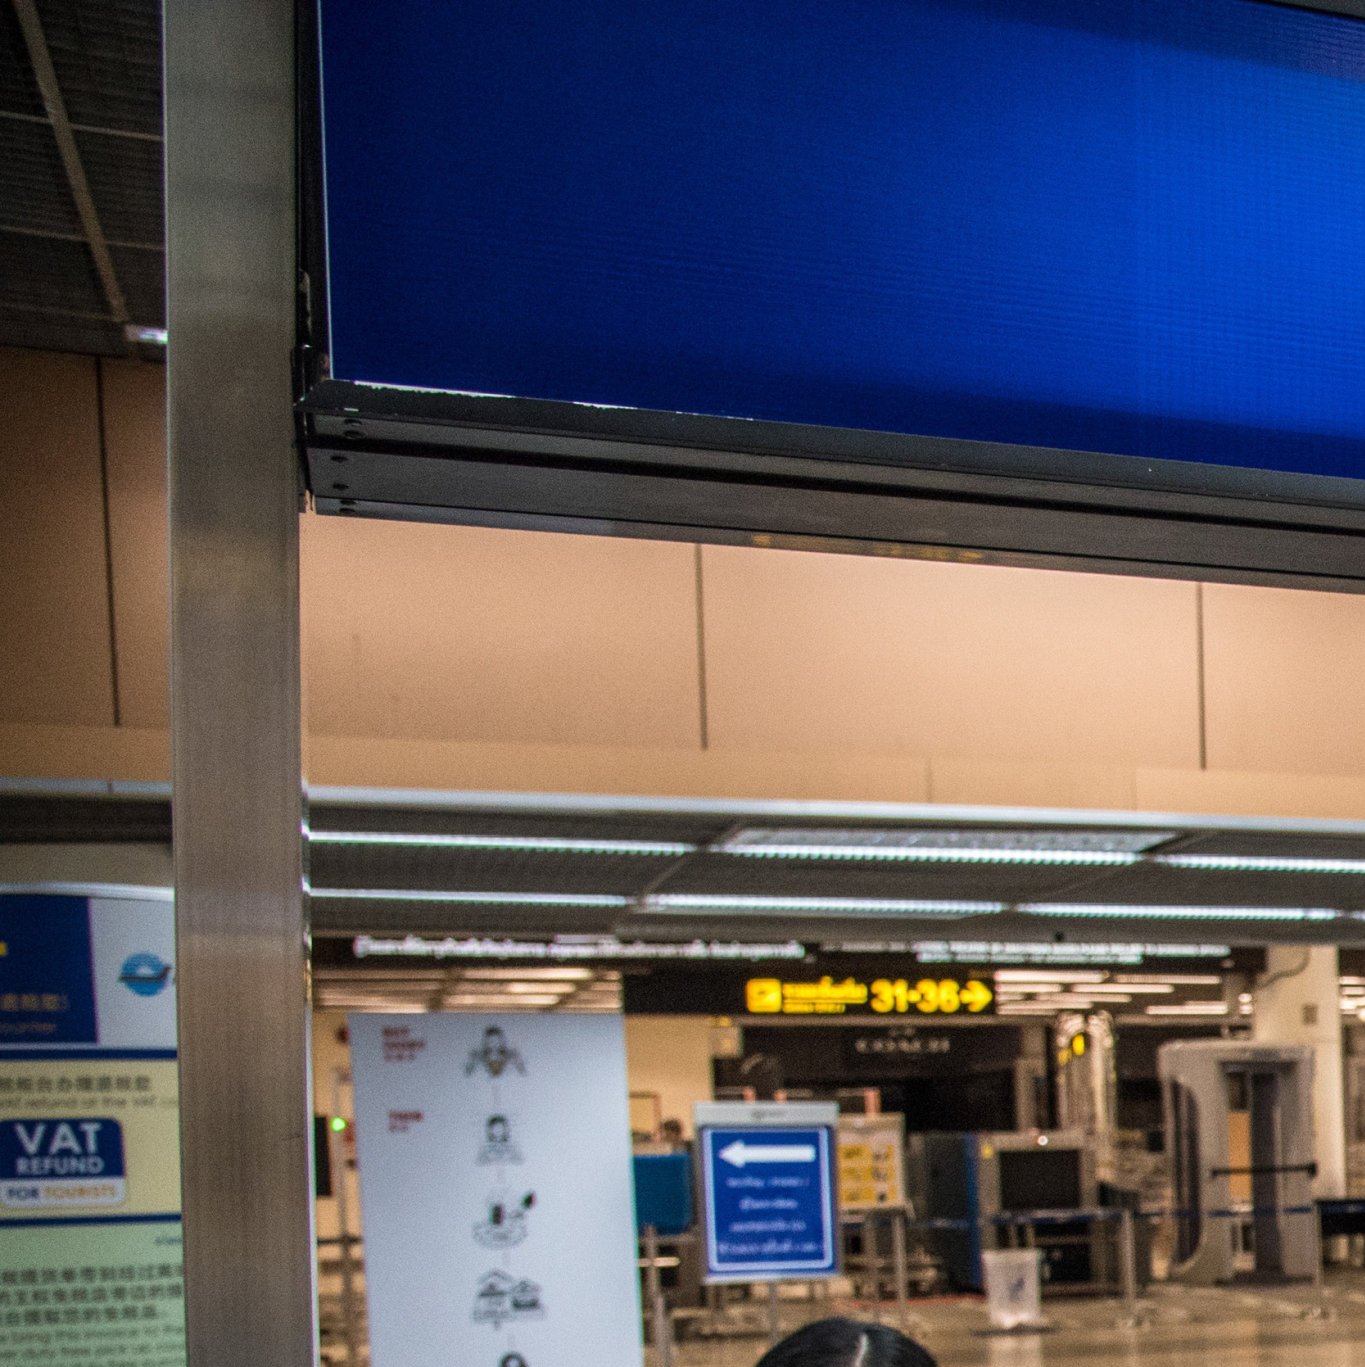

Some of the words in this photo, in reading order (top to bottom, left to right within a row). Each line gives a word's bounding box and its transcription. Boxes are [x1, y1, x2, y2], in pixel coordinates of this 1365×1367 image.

[870, 978, 960, 1014] 31-36
[14, 1121, 103, 1155] VAT
[16, 1155, 106, 1176] REFUND
